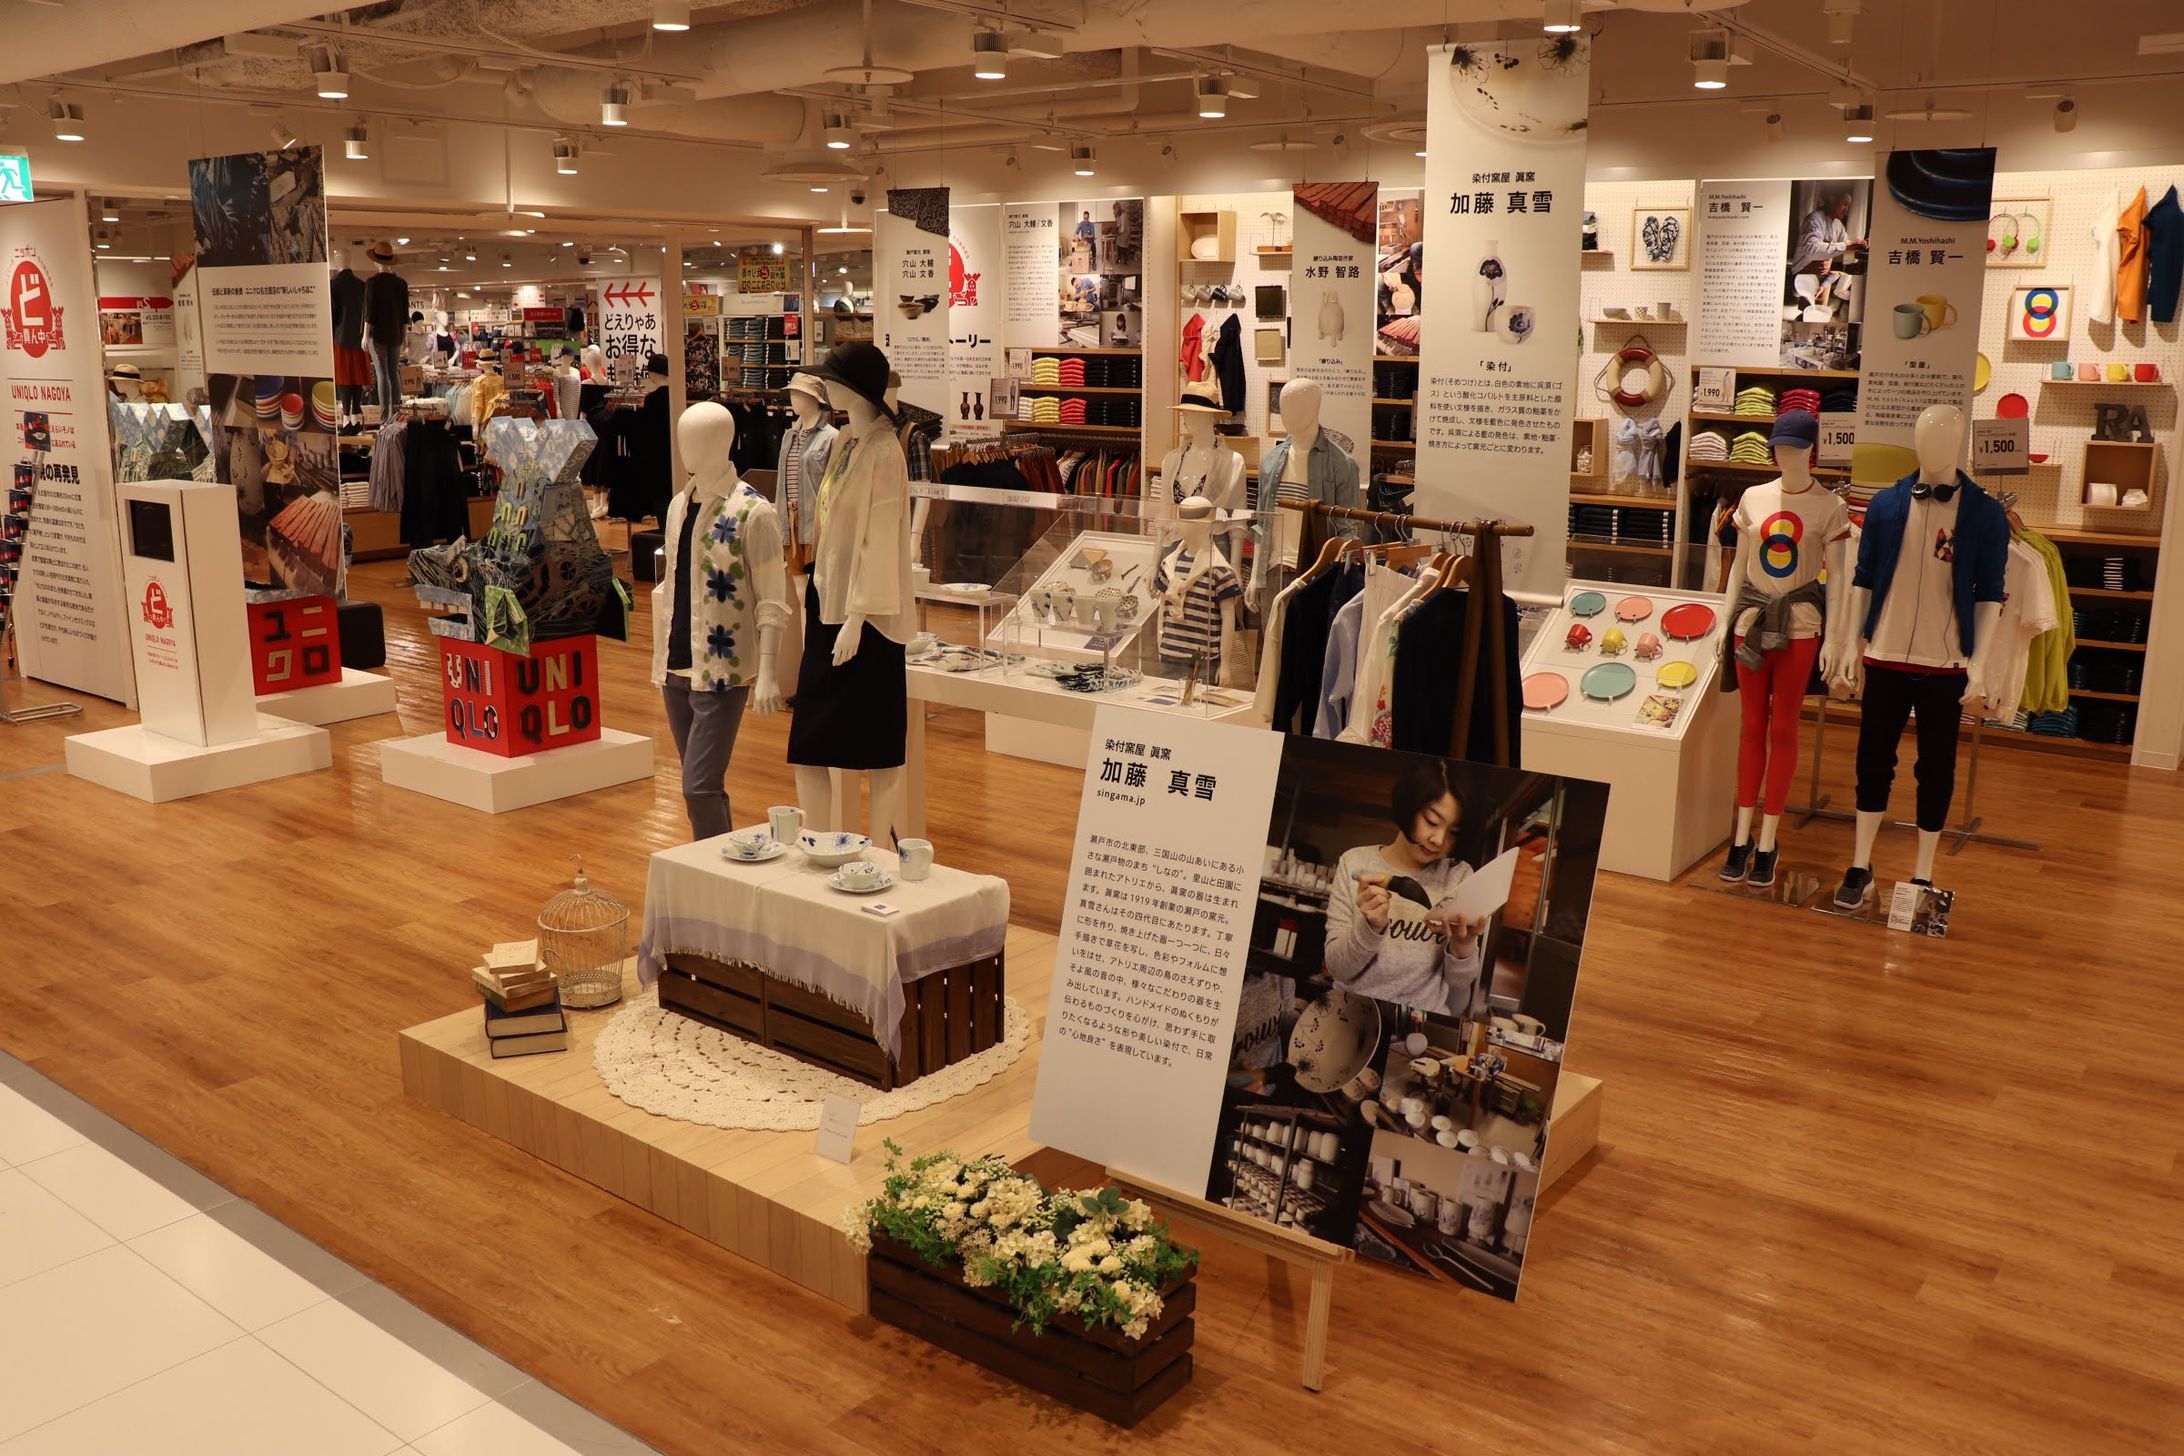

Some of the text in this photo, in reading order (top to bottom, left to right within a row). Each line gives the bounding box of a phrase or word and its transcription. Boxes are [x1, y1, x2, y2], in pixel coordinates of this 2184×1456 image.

[1472, 172, 1510, 183] 染付窯屋
[1450, 191, 1552, 214] 加藤 真雪
[1709, 202, 1763, 212] 吉橋 賢一
[902, 260, 916, 268] 穴山
[902, 270, 934, 278] 穴山 文香
[1306, 266, 1360, 278] 水野 智路
[1888, 250, 1963, 265] 吉橋 賢一
[19, 273, 45, 326] ど
[604, 312, 656, 331] どえりゃあ
[605, 334, 656, 360] お得な
[1480, 361, 1512, 372] 「染付」
[12, 385, 72, 402] UNIQLO NAGOYA
[1823, 432, 1855, 445] ¥1,500
[1979, 439, 2014, 454] ¥1,500
[446, 653, 492, 696] UNI
[517, 651, 583, 694] UNI
[451, 697, 499, 740] QLO
[520, 695, 592, 744] QLO
[1104, 738, 1171, 761] 染付窯屋 眞窯
[1099, 756, 1217, 802] 加藤 真雪
[1096, 788, 1146, 807] singama.jp
[1089, 833, 1244, 876] 瀬戸市の北東部、三国山の山あいにある小
[1076, 913, 1230, 961] に形を作り、焼き上げた器一つ一つに、日々
[1079, 897, 1233, 944] 真雪さんはその四代目にあたります。丁寧
[1071, 946, 1223, 995] いをはせ、アトリエ周辺の鳥のさえずりや、
[1074, 929, 1227, 978] 手描きで草花を写し、色彩やフォルムに想
[1066, 978, 1219, 1029] み出しています。ハンドメイドのぬくもりが
[1068, 961, 1221, 1012] そよ風の音の中、様々なこだわりの器を生
[1061, 1009, 1213, 1063] りたくなるような形や美しい染付で、日常
[1064, 993, 1216, 1045] 伝わるものづくりを心がけ、思わず手に取
